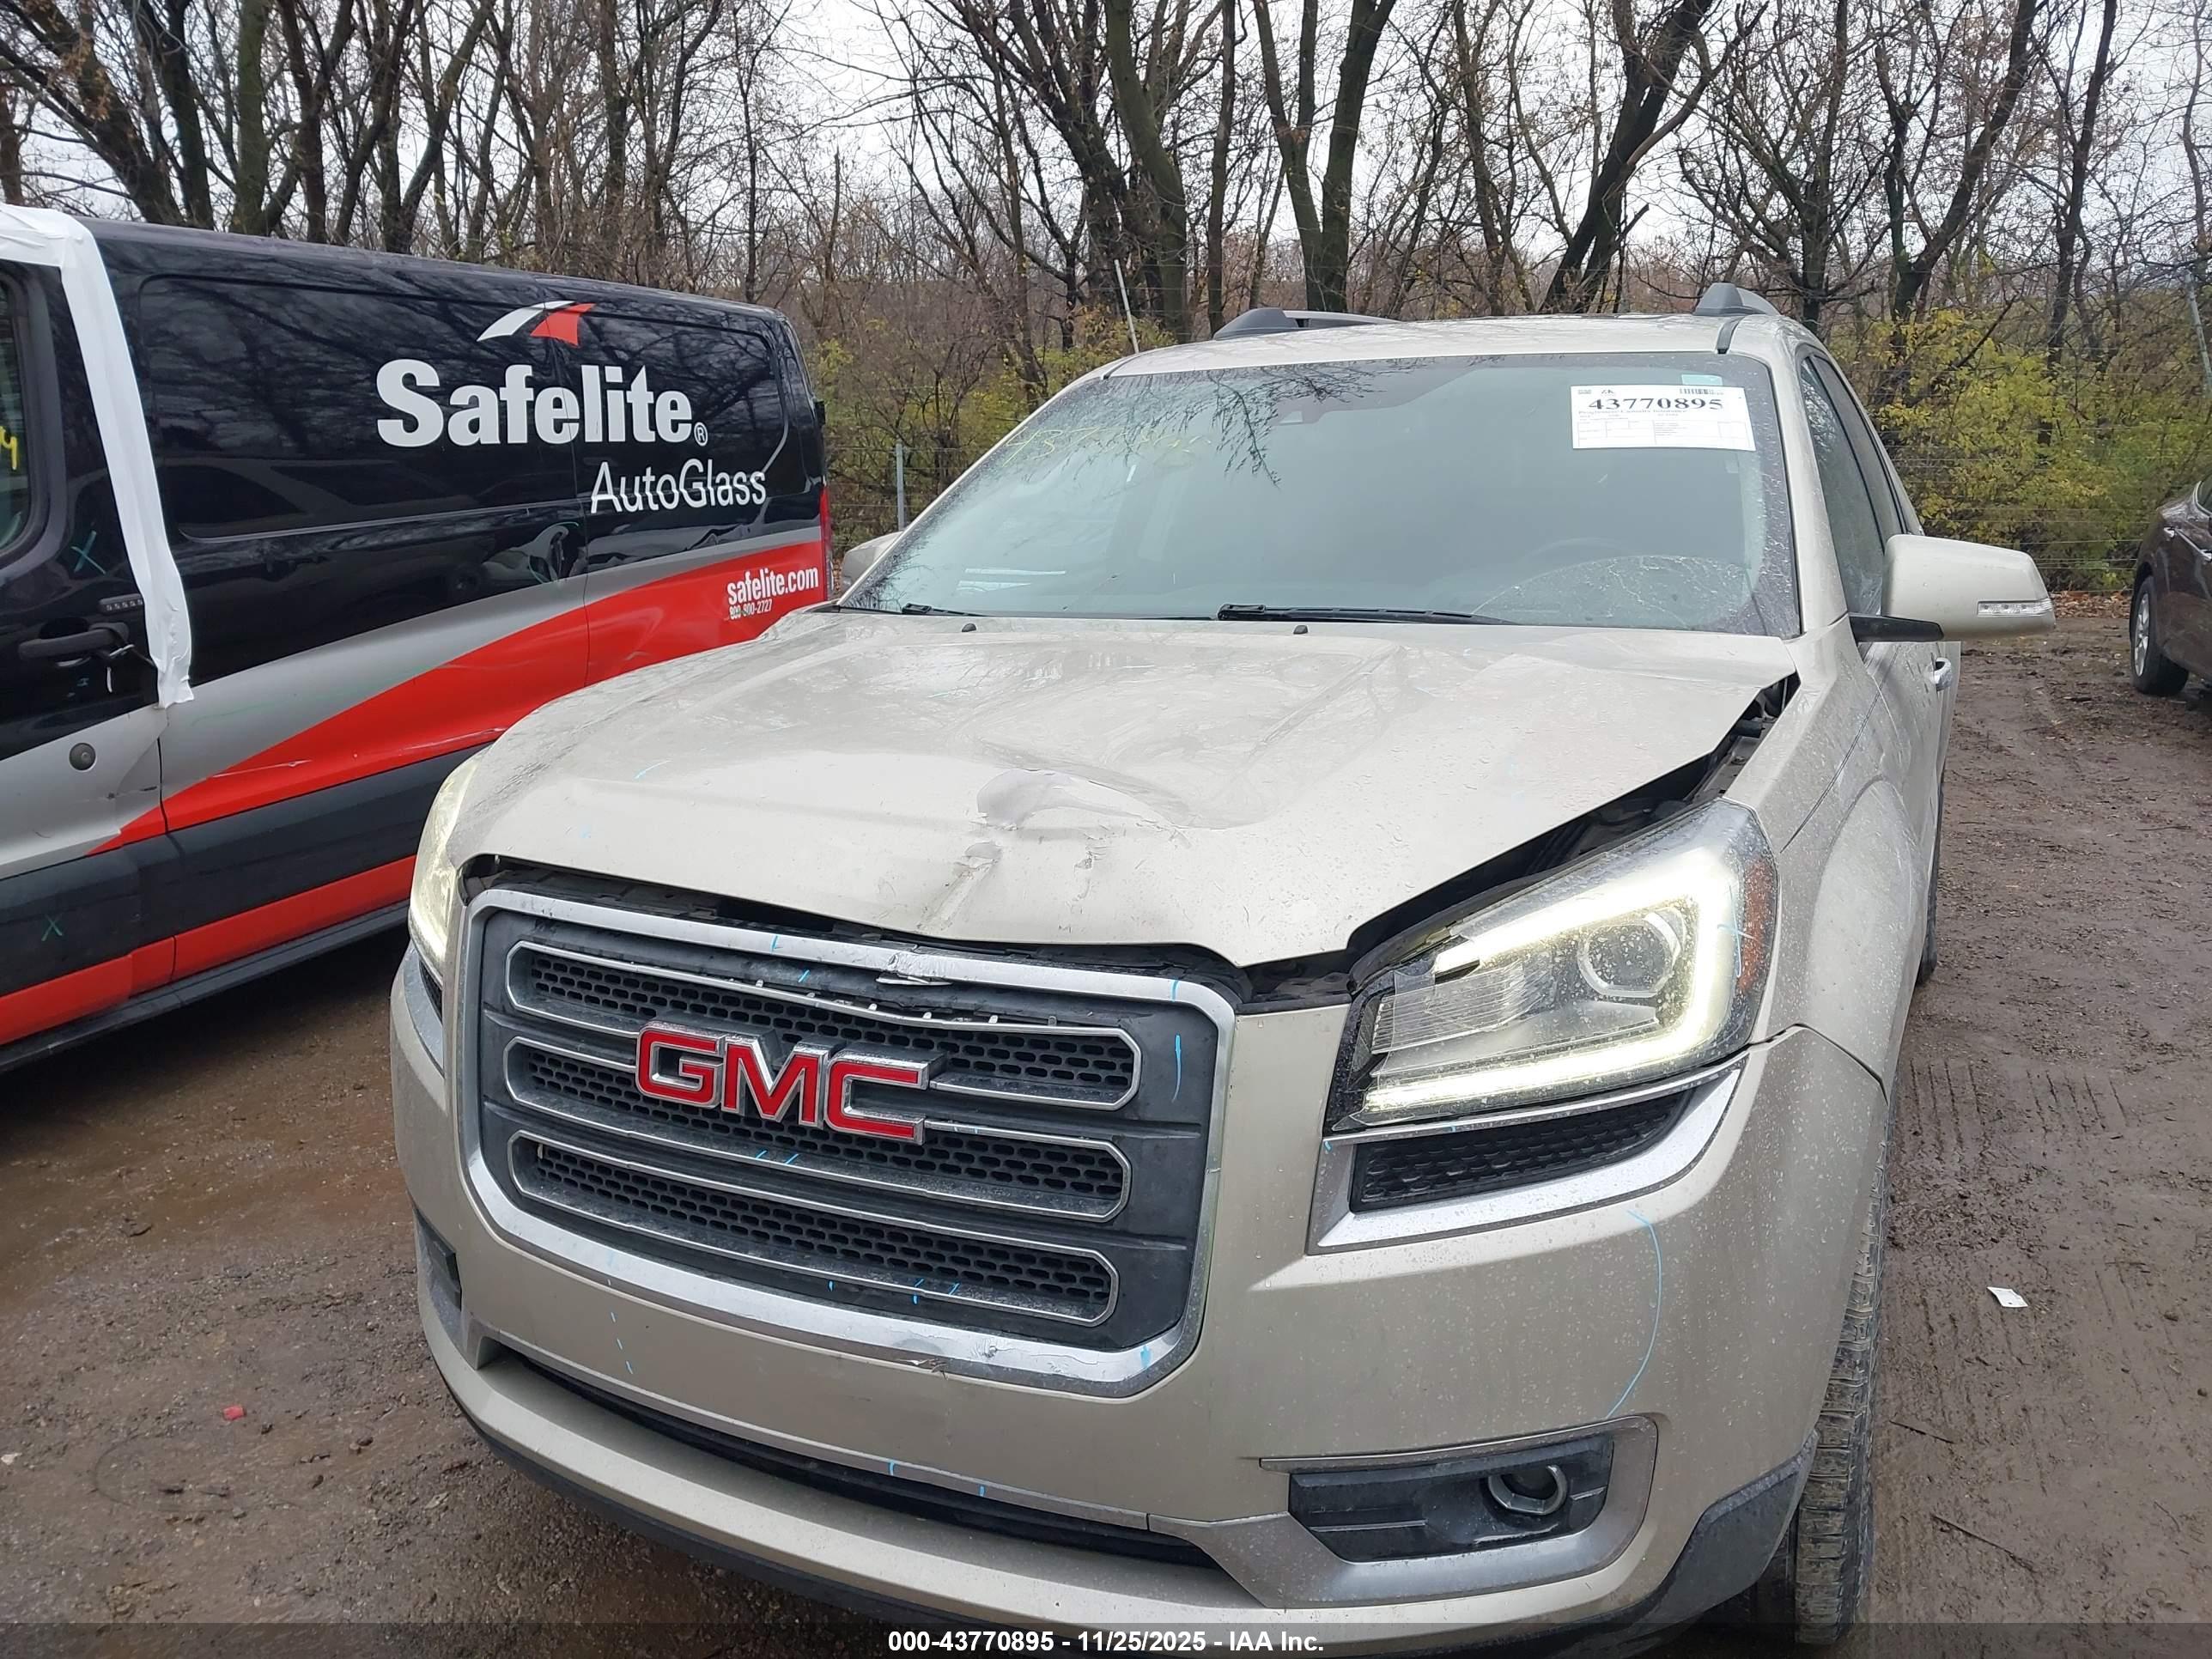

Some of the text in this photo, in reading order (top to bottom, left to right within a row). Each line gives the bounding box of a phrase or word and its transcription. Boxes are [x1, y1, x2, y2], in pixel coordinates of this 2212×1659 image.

[1589, 398, 1723, 410] 43770895
[590, 459, 767, 514] AutoGlass
[727, 567, 819, 605] safelite.com
[635, 1020, 930, 1146] GMC
